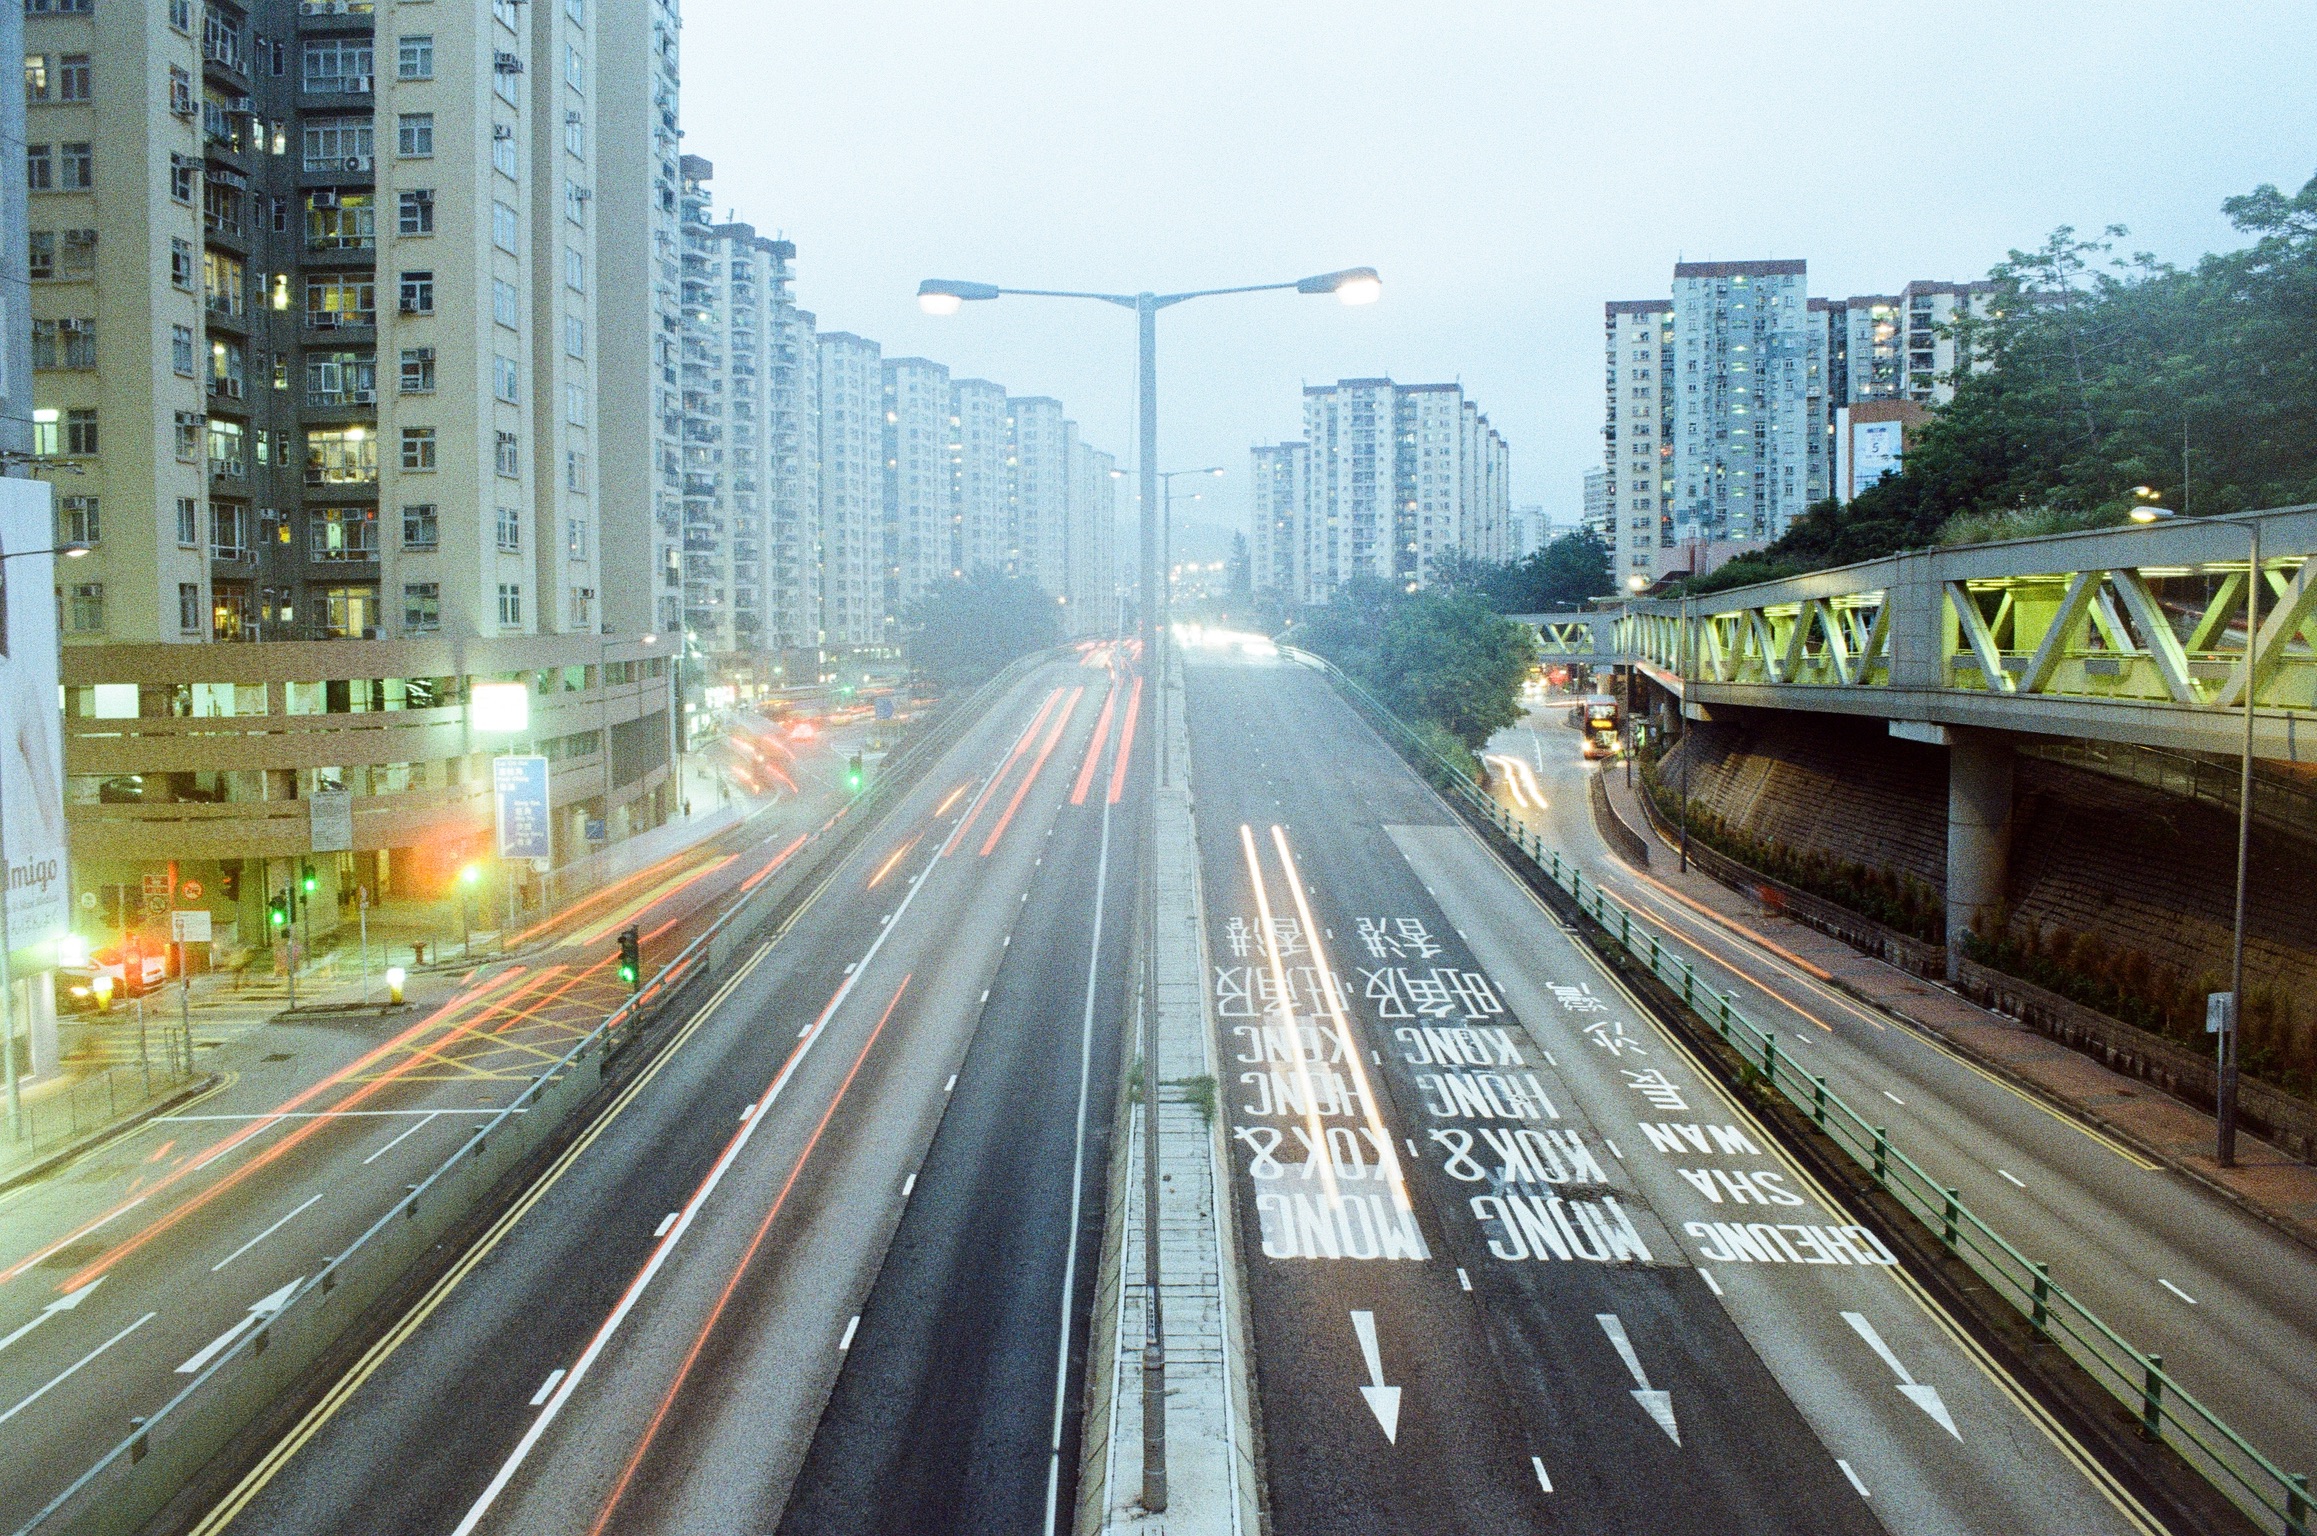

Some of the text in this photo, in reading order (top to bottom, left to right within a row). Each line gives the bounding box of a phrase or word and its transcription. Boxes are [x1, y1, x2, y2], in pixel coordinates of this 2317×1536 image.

[1356, 917, 1444, 958] 香港
[1214, 966, 1350, 1018] 旺角及
[1356, 967, 1504, 1018] 旺角及
[1234, 1026, 1349, 1063] KONG
[1395, 1027, 1525, 1065] KONG
[1241, 1073, 1373, 1117] HONG
[1418, 1073, 1560, 1119] HONG
[1234, 1126, 1404, 1181] KOK &
[1430, 1128, 1609, 1184] KOK &
[1638, 1122, 1761, 1155] WAN
[1678, 1168, 1805, 1206] SHA
[1255, 1194, 1431, 1260] MONG
[1470, 1195, 1654, 1261] MONG
[1683, 1221, 1900, 1266] CHEUNG
